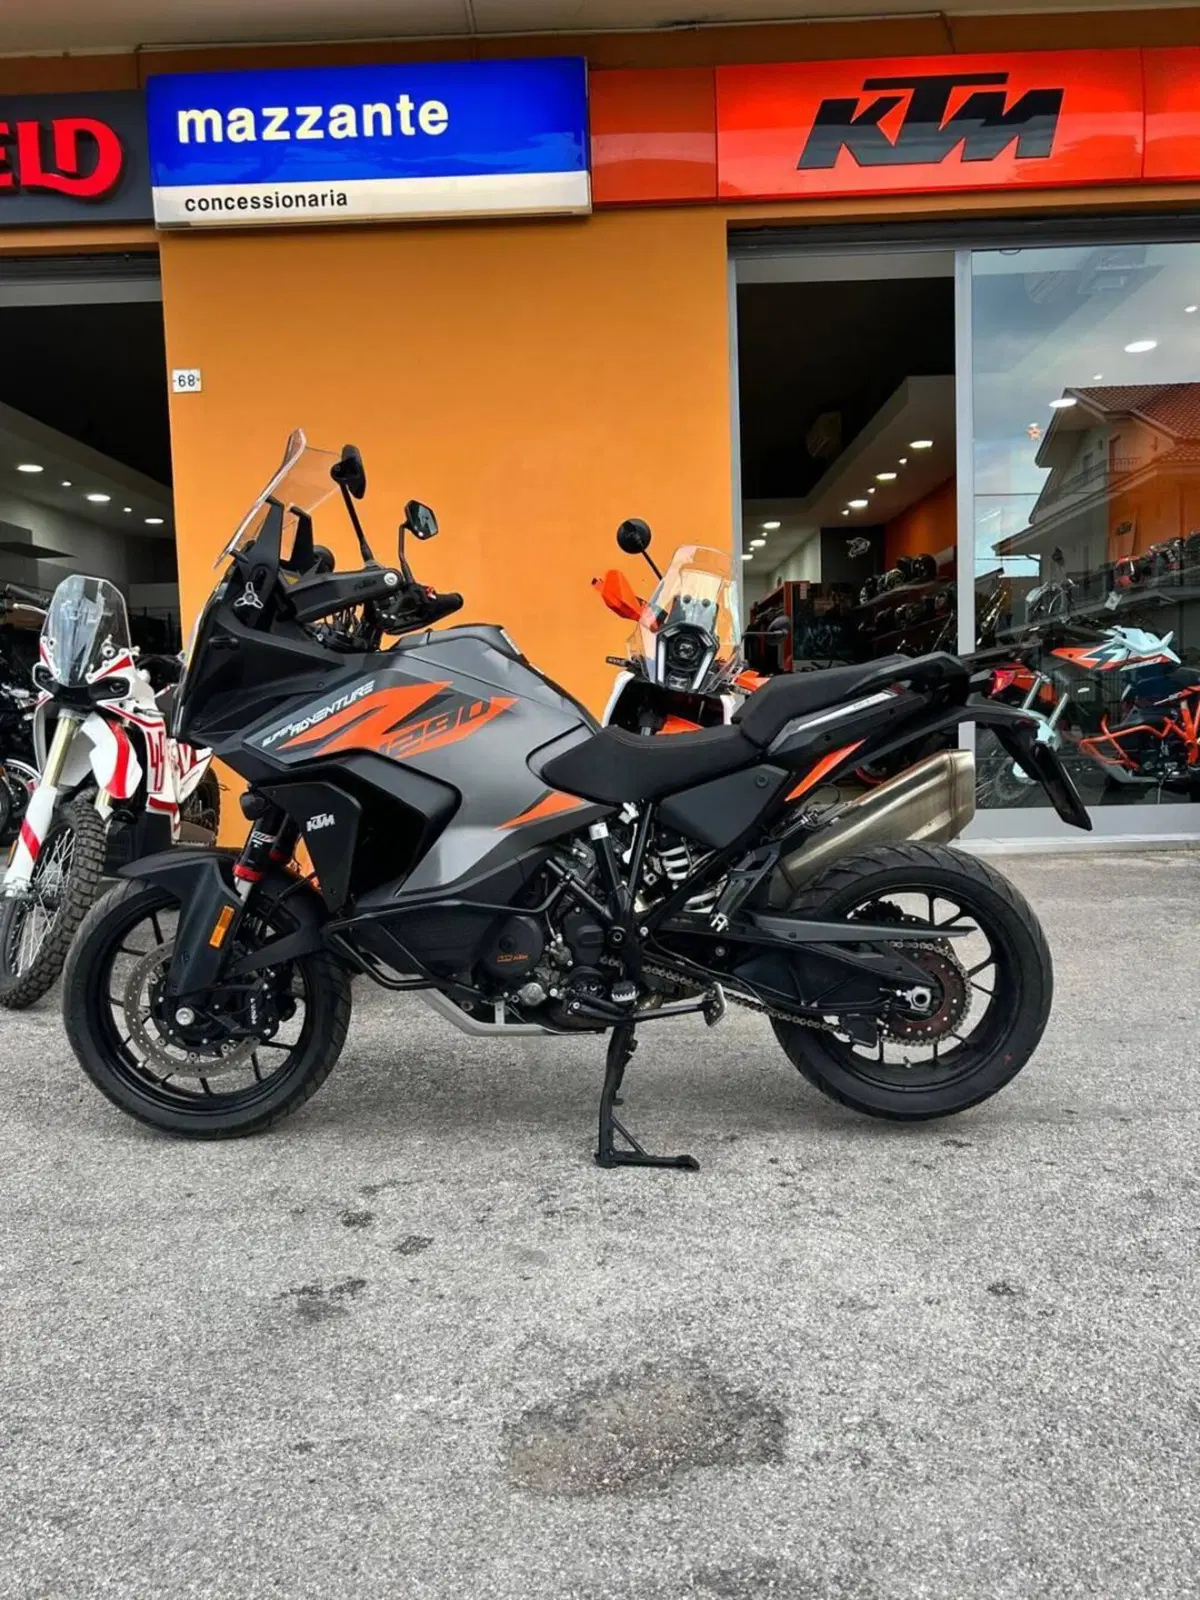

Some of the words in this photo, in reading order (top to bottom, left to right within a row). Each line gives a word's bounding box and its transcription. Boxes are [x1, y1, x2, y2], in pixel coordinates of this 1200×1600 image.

[177, 94, 450, 143] mazzante
[797, 72, 1064, 170] KTM
[185, 189, 347, 212] concessionaria
[178, 374, 196, 387] 68
[290, 680, 375, 736] ADVENTURE
[306, 813, 335, 832] KTM
